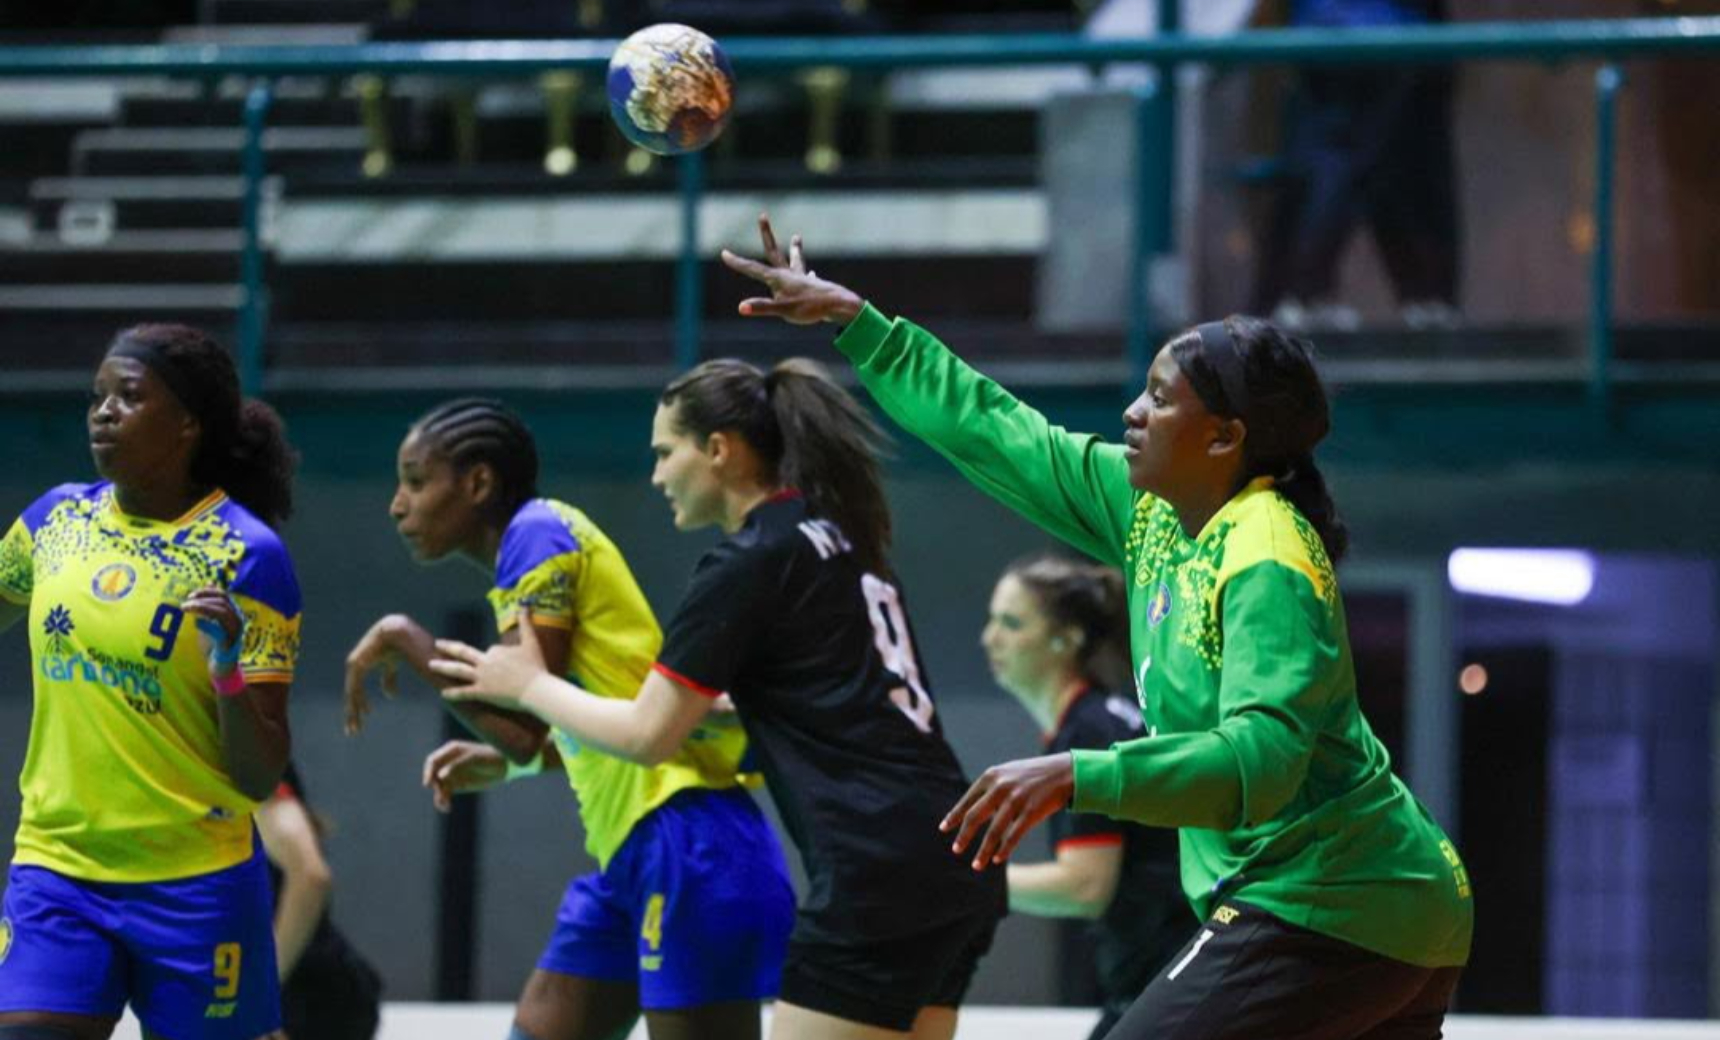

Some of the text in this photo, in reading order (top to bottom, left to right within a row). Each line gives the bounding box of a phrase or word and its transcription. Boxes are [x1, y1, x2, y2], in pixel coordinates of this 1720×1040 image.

[144, 603, 184, 661] 9
[859, 571, 934, 733] 9
[641, 894, 665, 951] 4
[214, 943, 241, 999] 9
